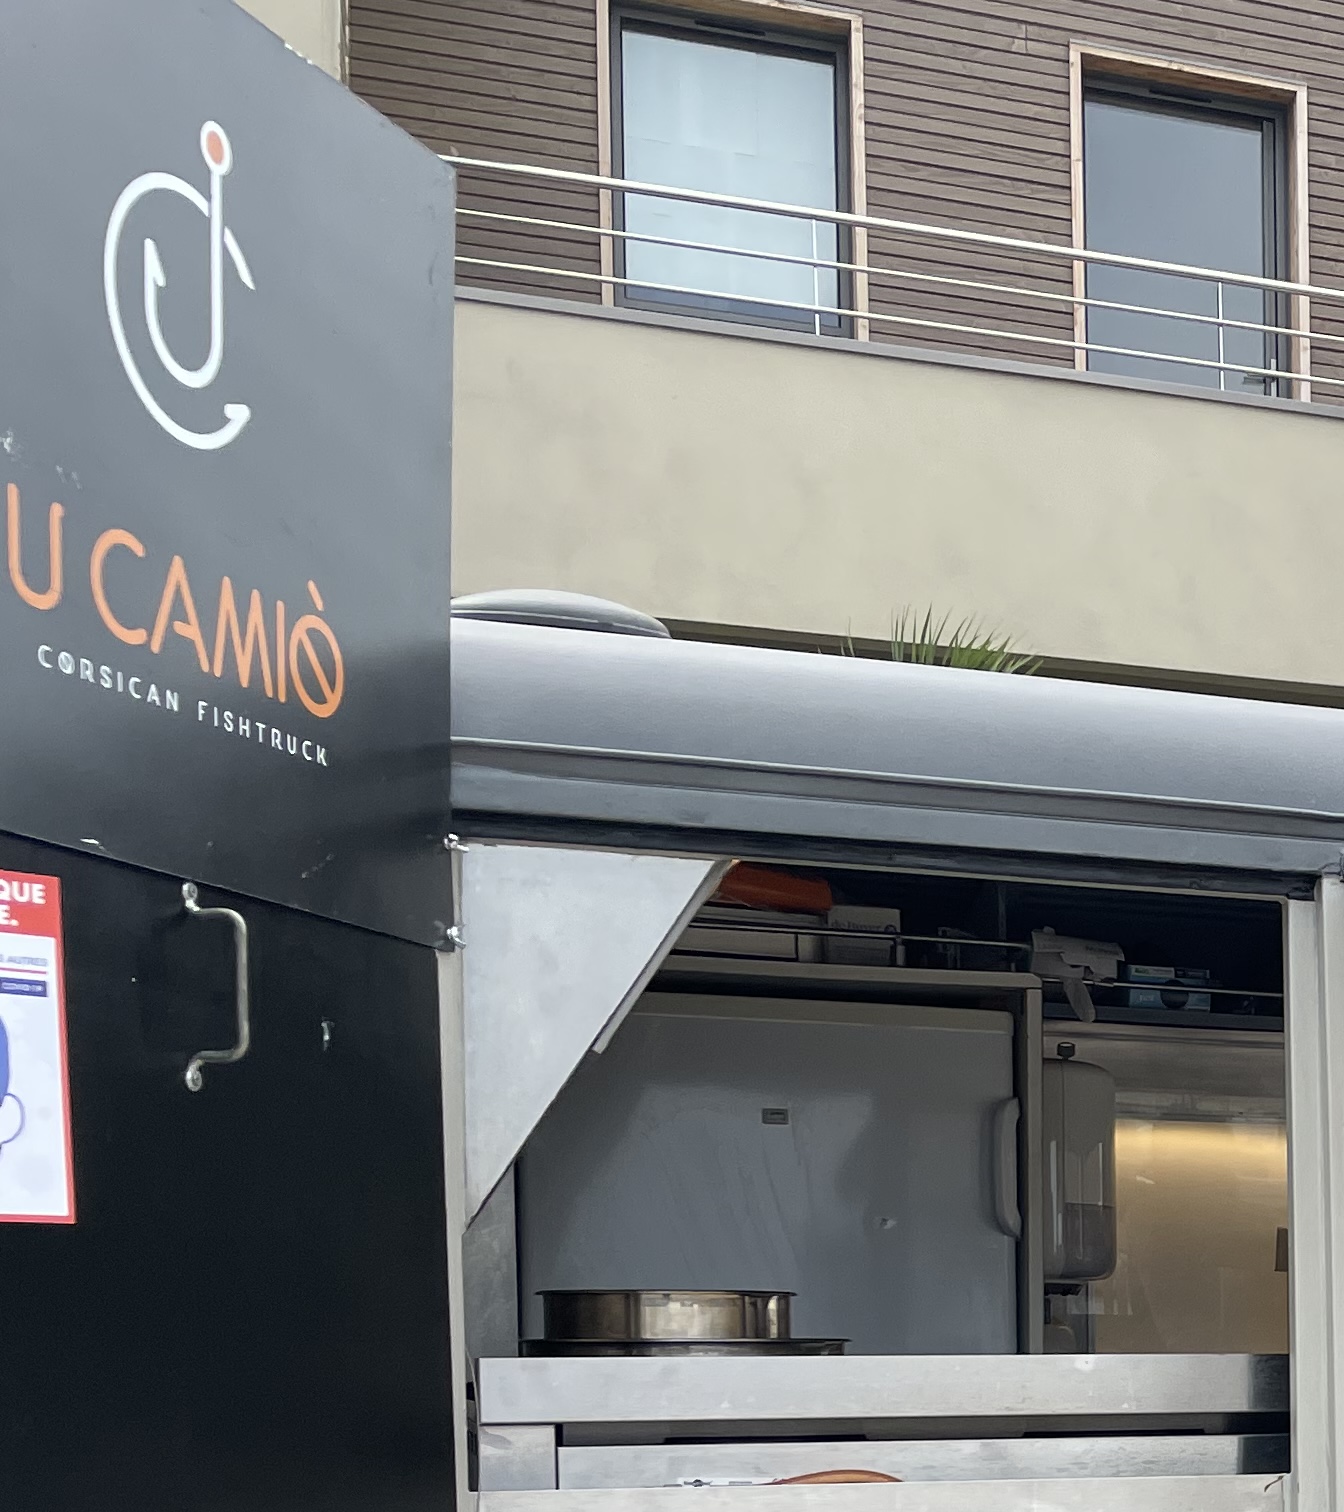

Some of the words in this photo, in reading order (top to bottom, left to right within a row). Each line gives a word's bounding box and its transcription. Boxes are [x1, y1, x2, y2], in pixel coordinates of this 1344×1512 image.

[6, 483, 64, 610] U
[90, 528, 344, 718] CAMIÒ
[37, 643, 180, 713] CORSICAN
[197, 700, 329, 767] FISHTRUCK
